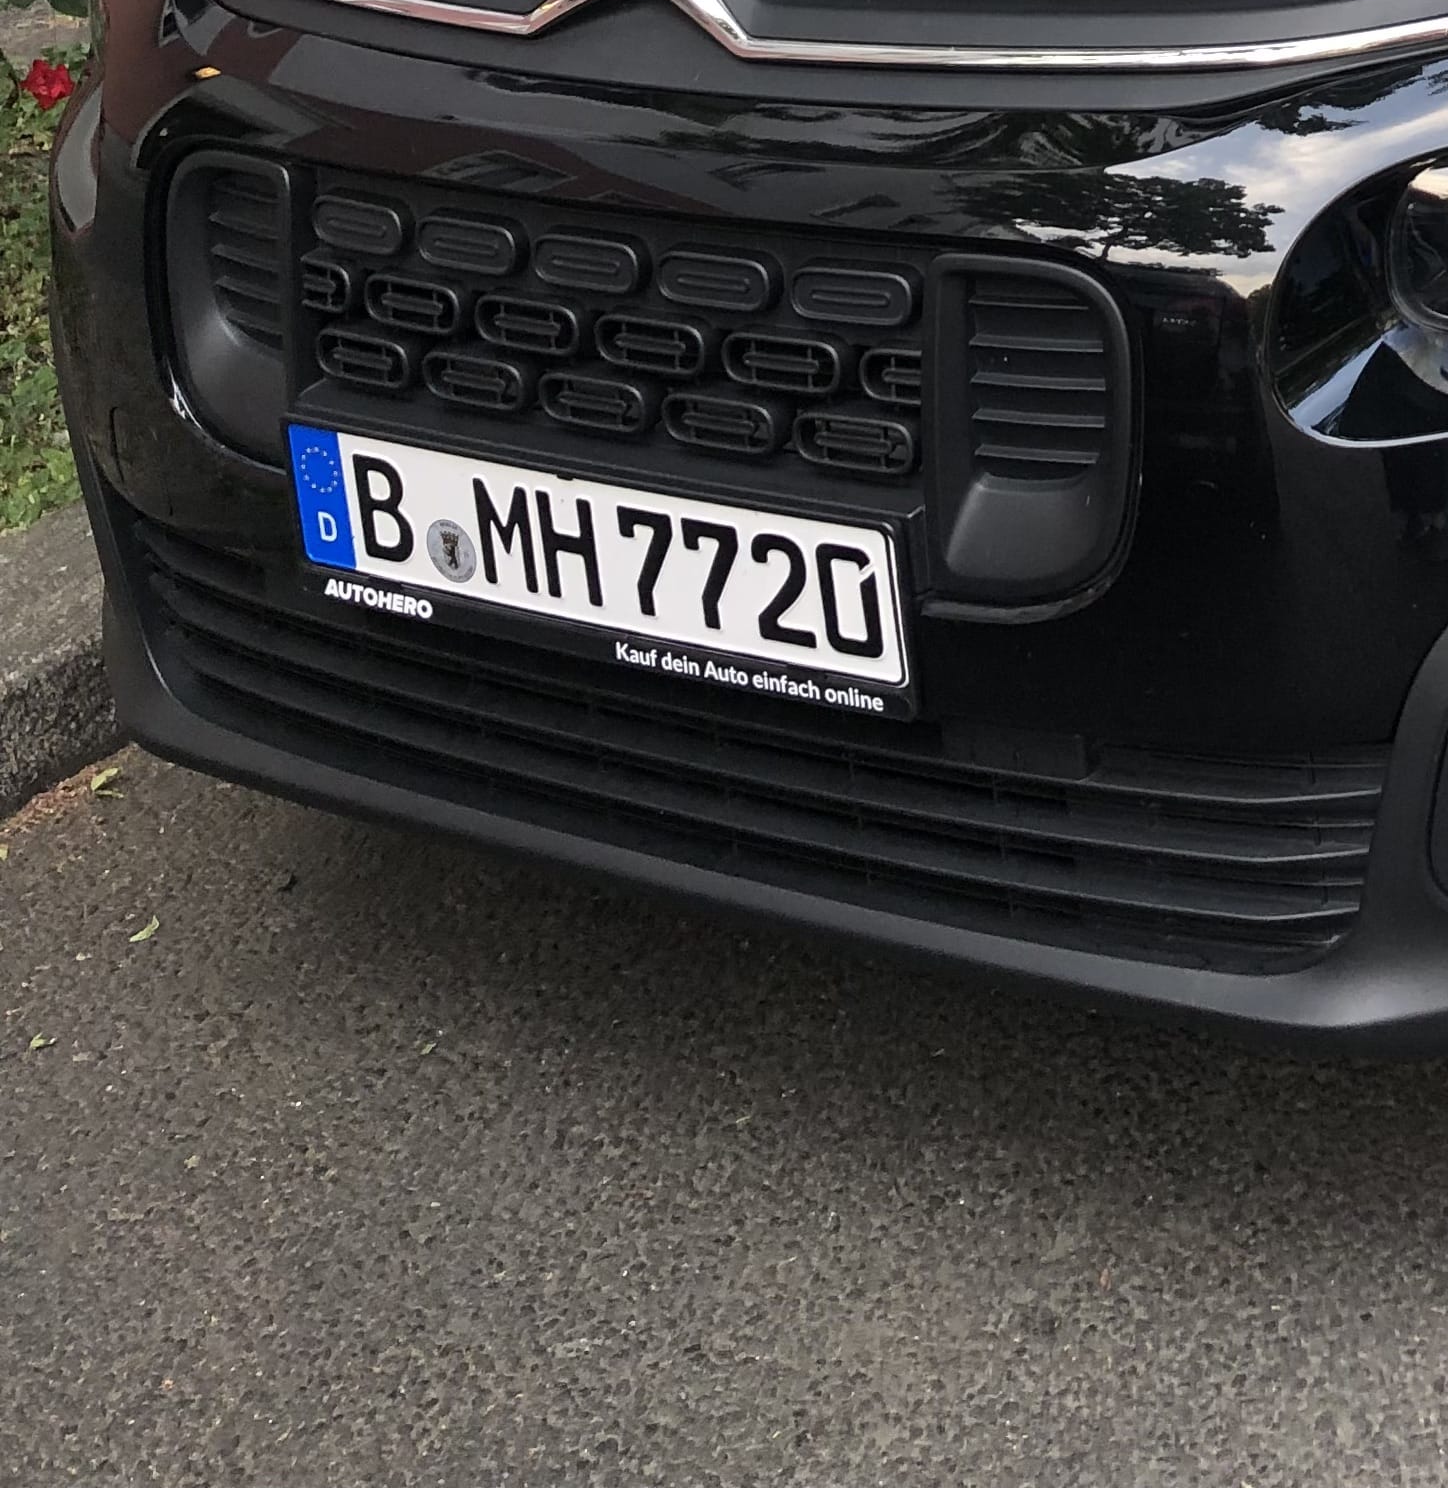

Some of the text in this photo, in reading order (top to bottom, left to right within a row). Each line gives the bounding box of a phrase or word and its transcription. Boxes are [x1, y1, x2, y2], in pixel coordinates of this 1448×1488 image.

[317, 511, 338, 543] D
[352, 453, 415, 564] B
[615, 504, 885, 660] 7720
[323, 578, 434, 619] AUTOHERO
[615, 641, 885, 713] Kauf dein Auto einfach online
